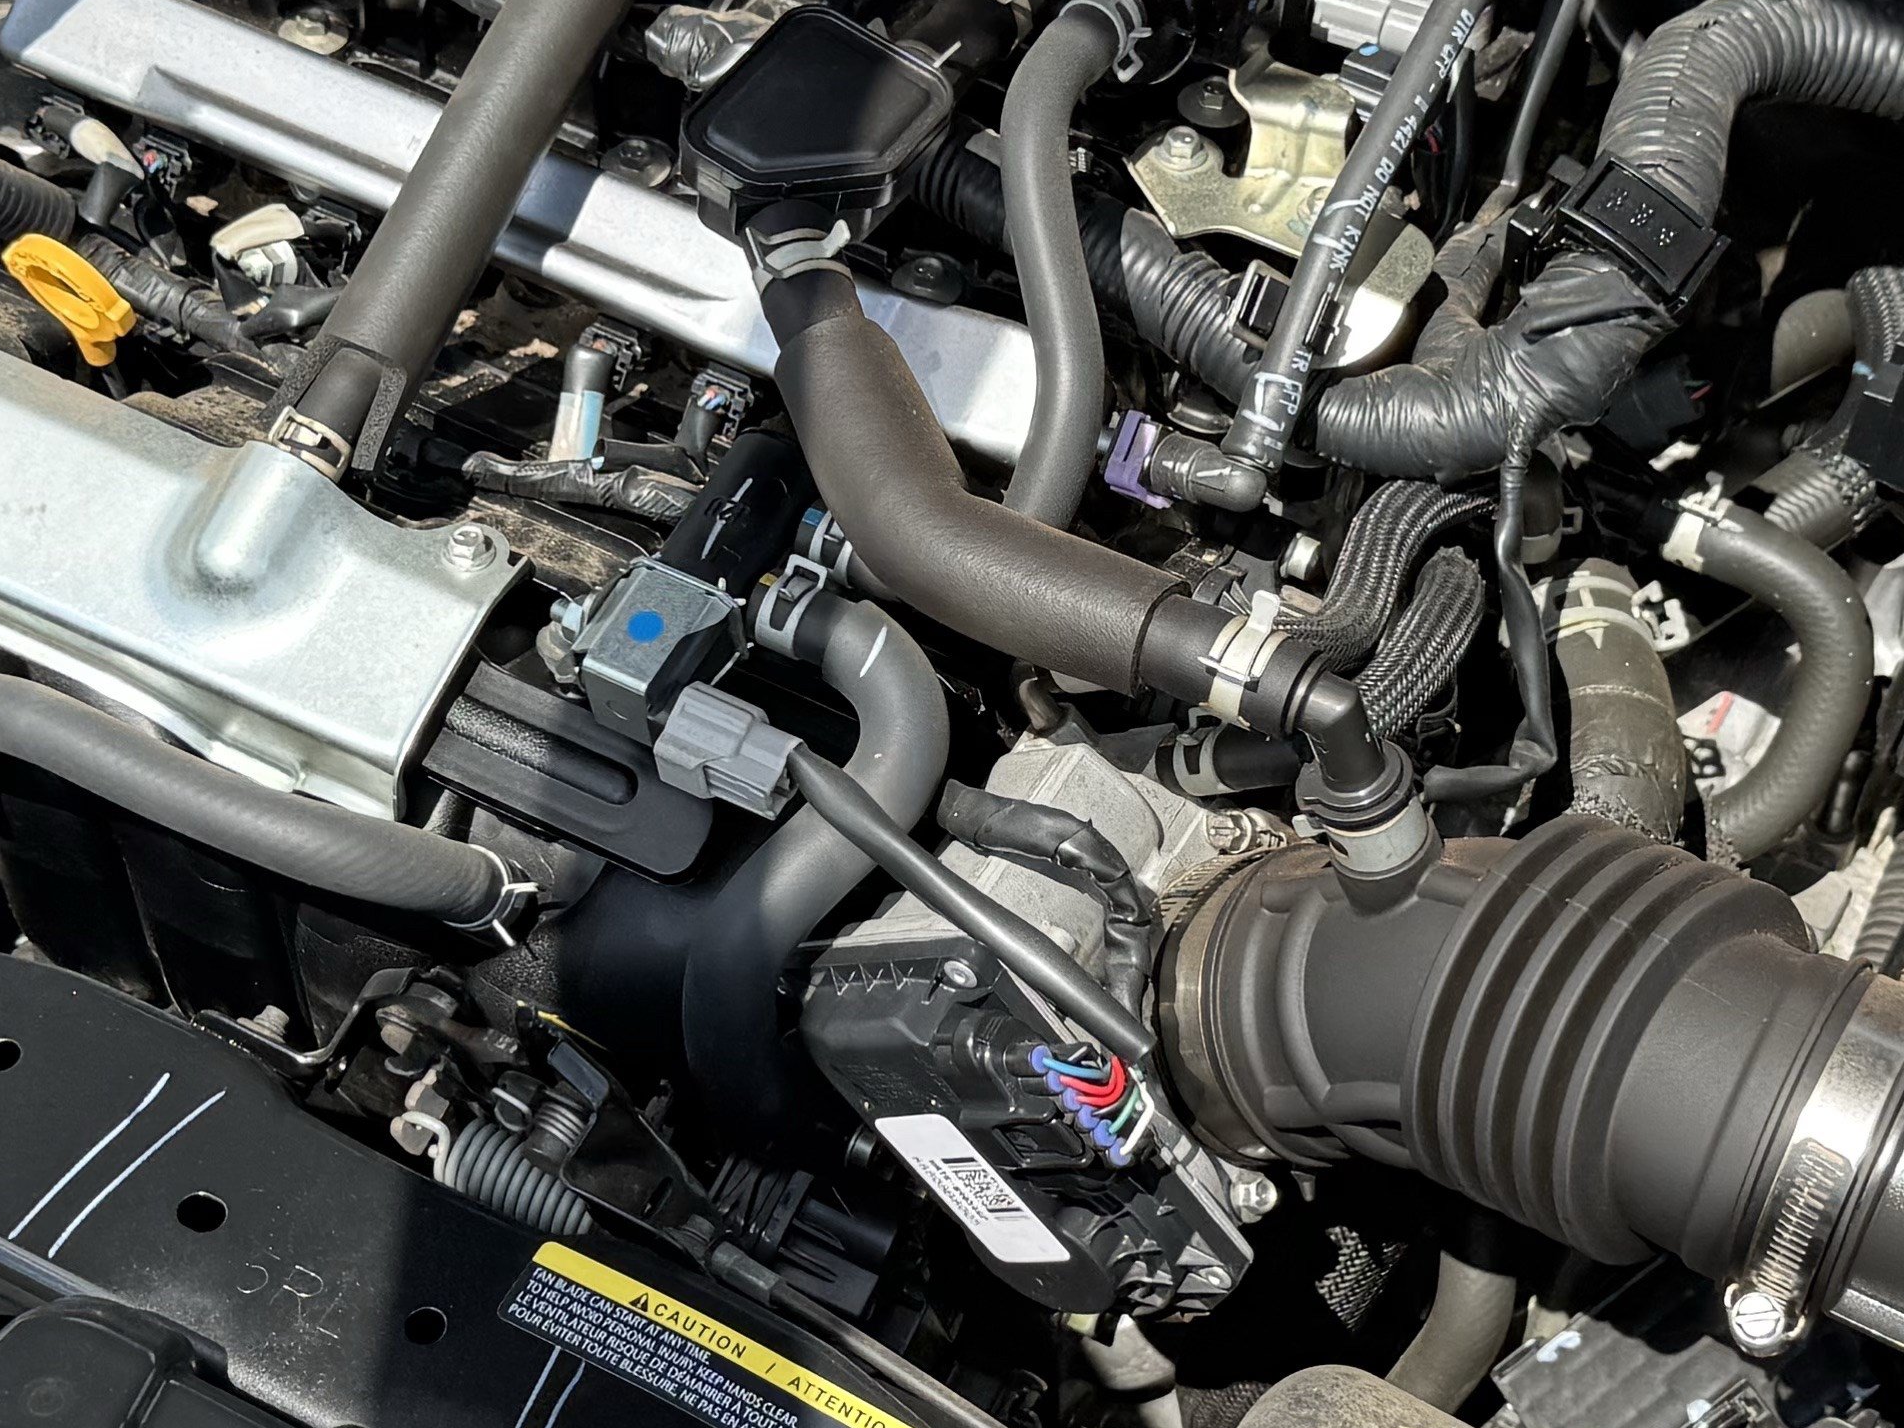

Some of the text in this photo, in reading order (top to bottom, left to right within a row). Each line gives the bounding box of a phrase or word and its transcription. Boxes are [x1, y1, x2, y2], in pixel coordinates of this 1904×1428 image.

[1351, 183, 1382, 221] NOT
[1372, 156, 1397, 184] DO
[1326, 223, 1364, 274] KINK
[516, 1288, 533, 1306] LE
[530, 1295, 608, 1345] VENTILATEUR
[604, 1333, 651, 1367] RISQUE
[648, 1355, 668, 1374] DE
[664, 1361, 735, 1409] DÉMARRER
[731, 1395, 746, 1415] À
[525, 1278, 544, 1296] TO
[540, 1286, 570, 1310] HELP
[567, 1299, 604, 1326] AVOID
[601, 1316, 658, 1354] PERSONAL
[694, 1363, 726, 1388] KEEP
[721, 1379, 765, 1410] HANDS
[531, 1266, 714, 1366] FAN BLADE CAN START AT ANY TIME.
[651, 1300, 748, 1361] CAUTION
[506, 1300, 543, 1328] POUR
[540, 1315, 584, 1349] ÉVITER
[579, 1336, 621, 1367] TOUTE
[677, 1387, 699, 1407] NE
[696, 1397, 723, 1420] PAS
